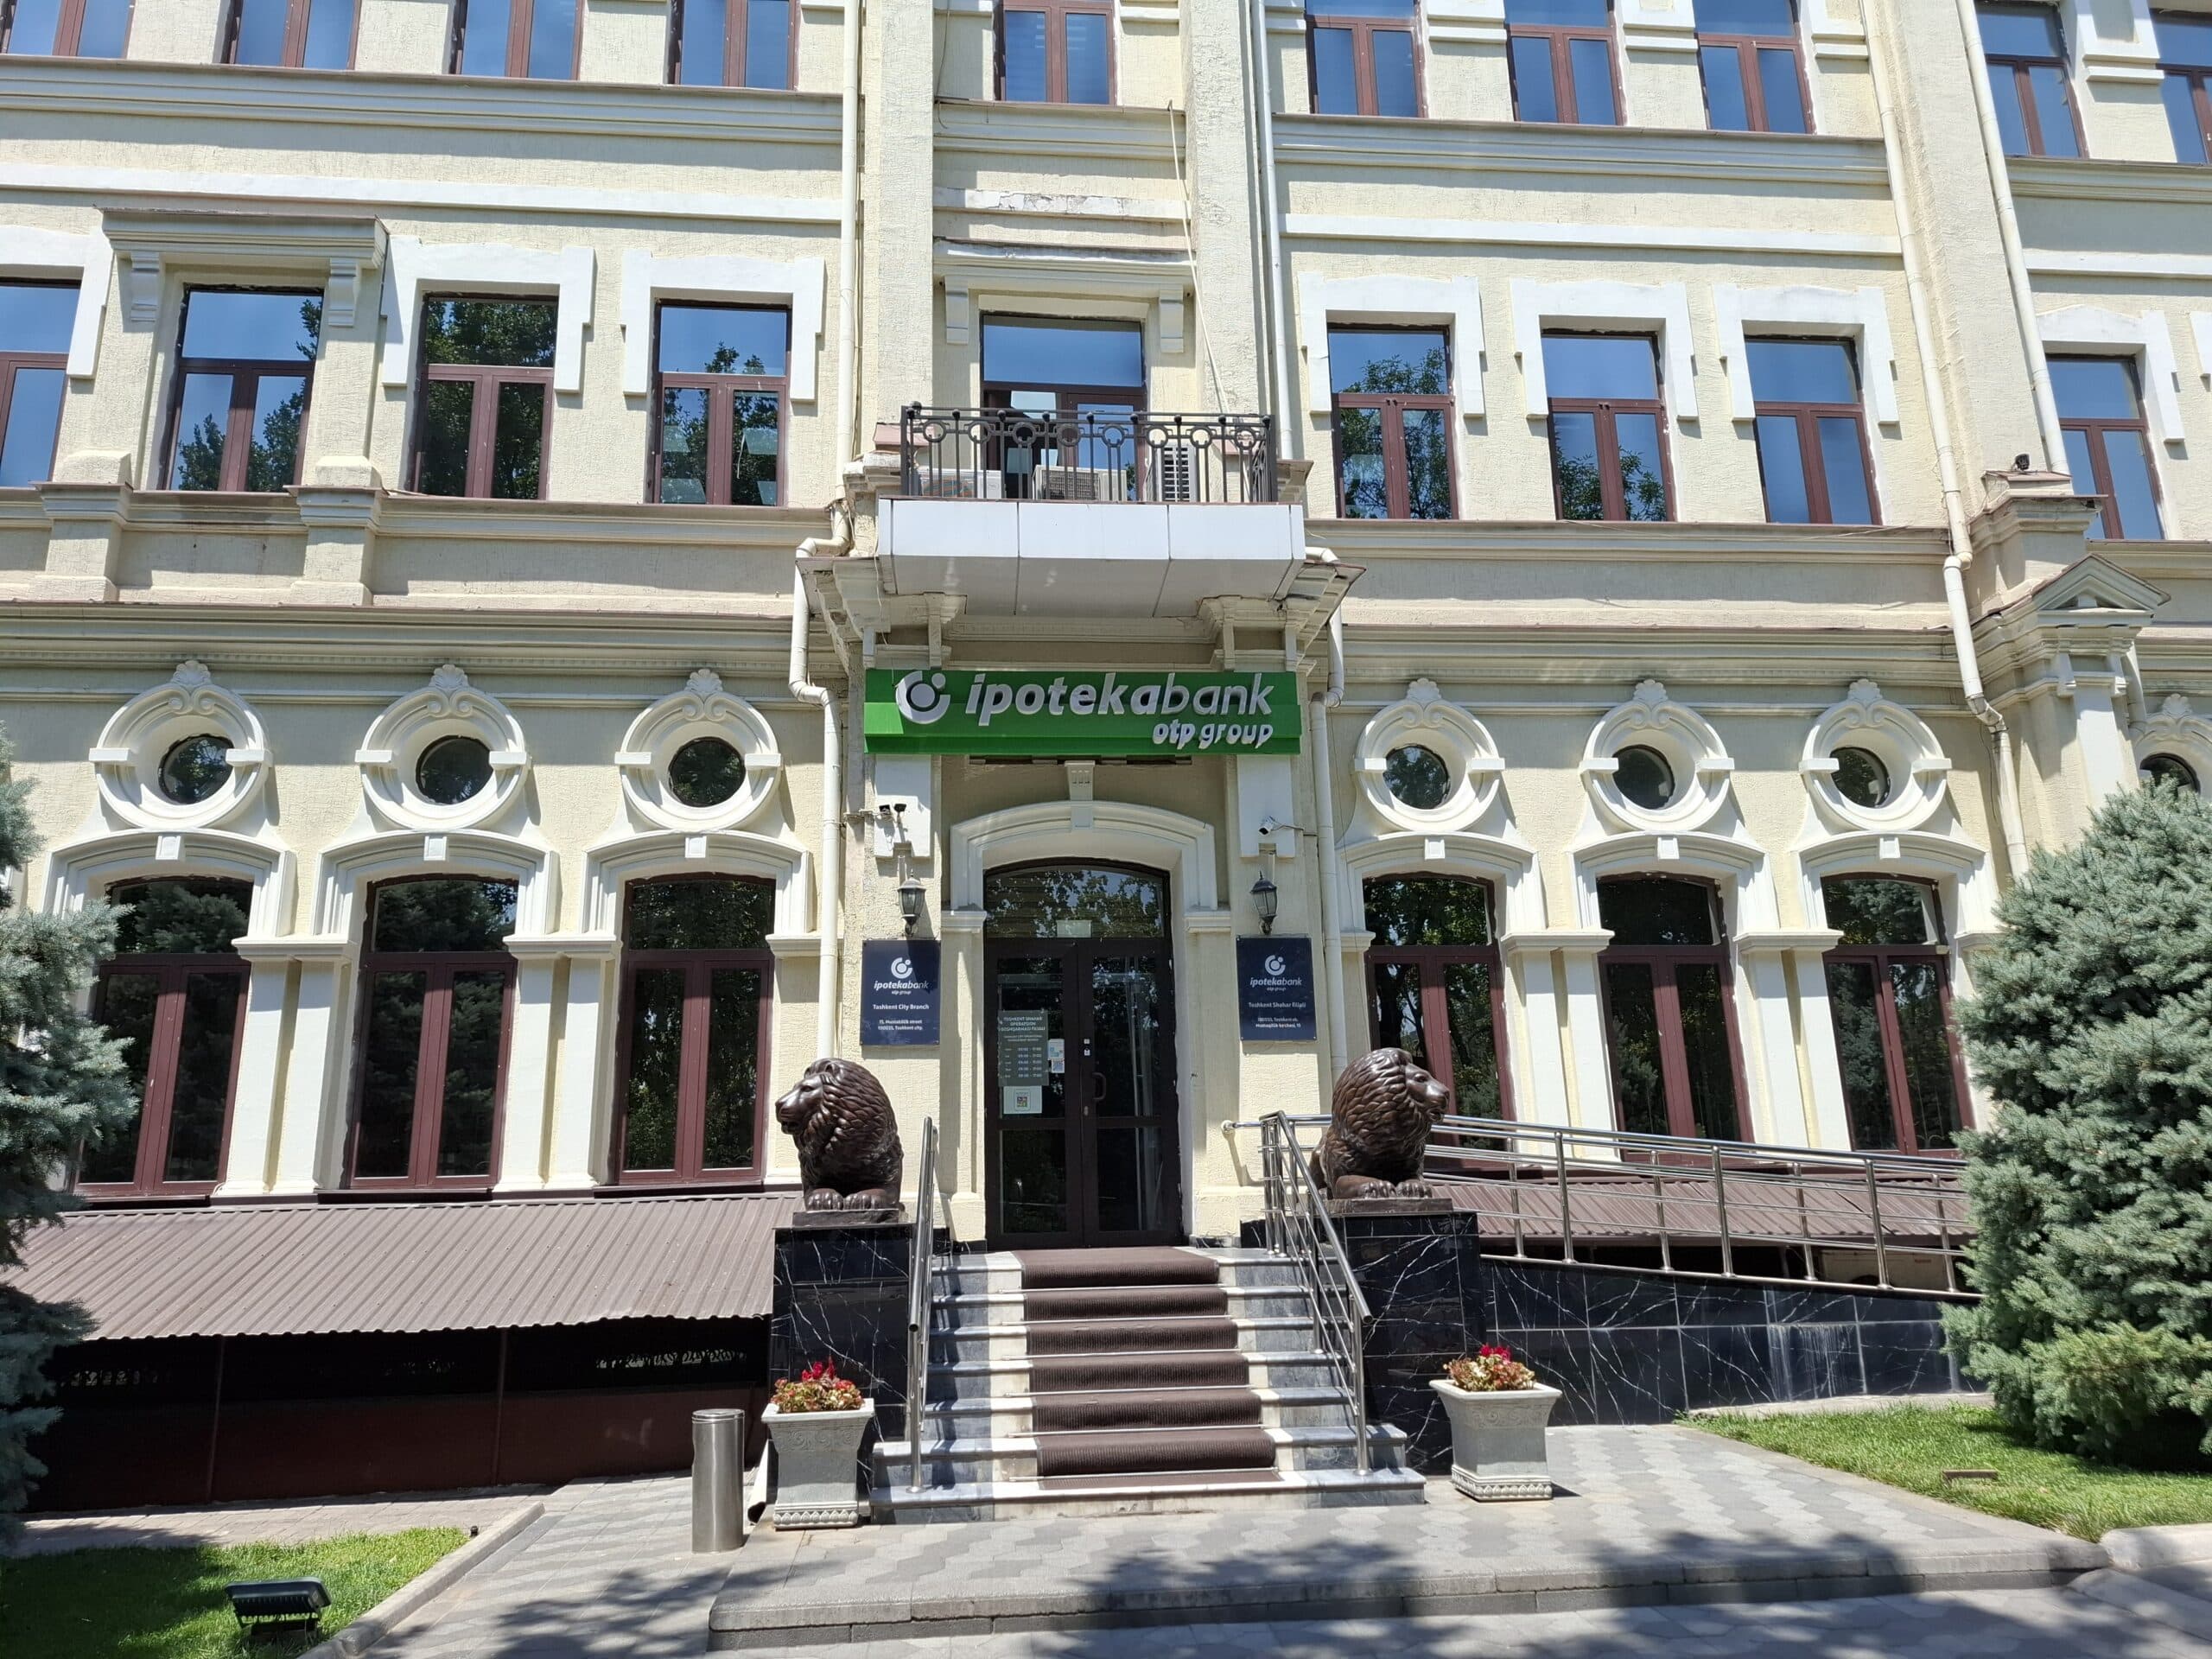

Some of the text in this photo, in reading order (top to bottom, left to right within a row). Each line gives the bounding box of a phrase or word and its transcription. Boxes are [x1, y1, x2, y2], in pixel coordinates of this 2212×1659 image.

[965, 671, 1274, 727] ipotekabank
[1152, 718, 1274, 750] otp group
[874, 980, 929, 991] ipotekabank
[1249, 976, 1302, 988] ipotekabank
